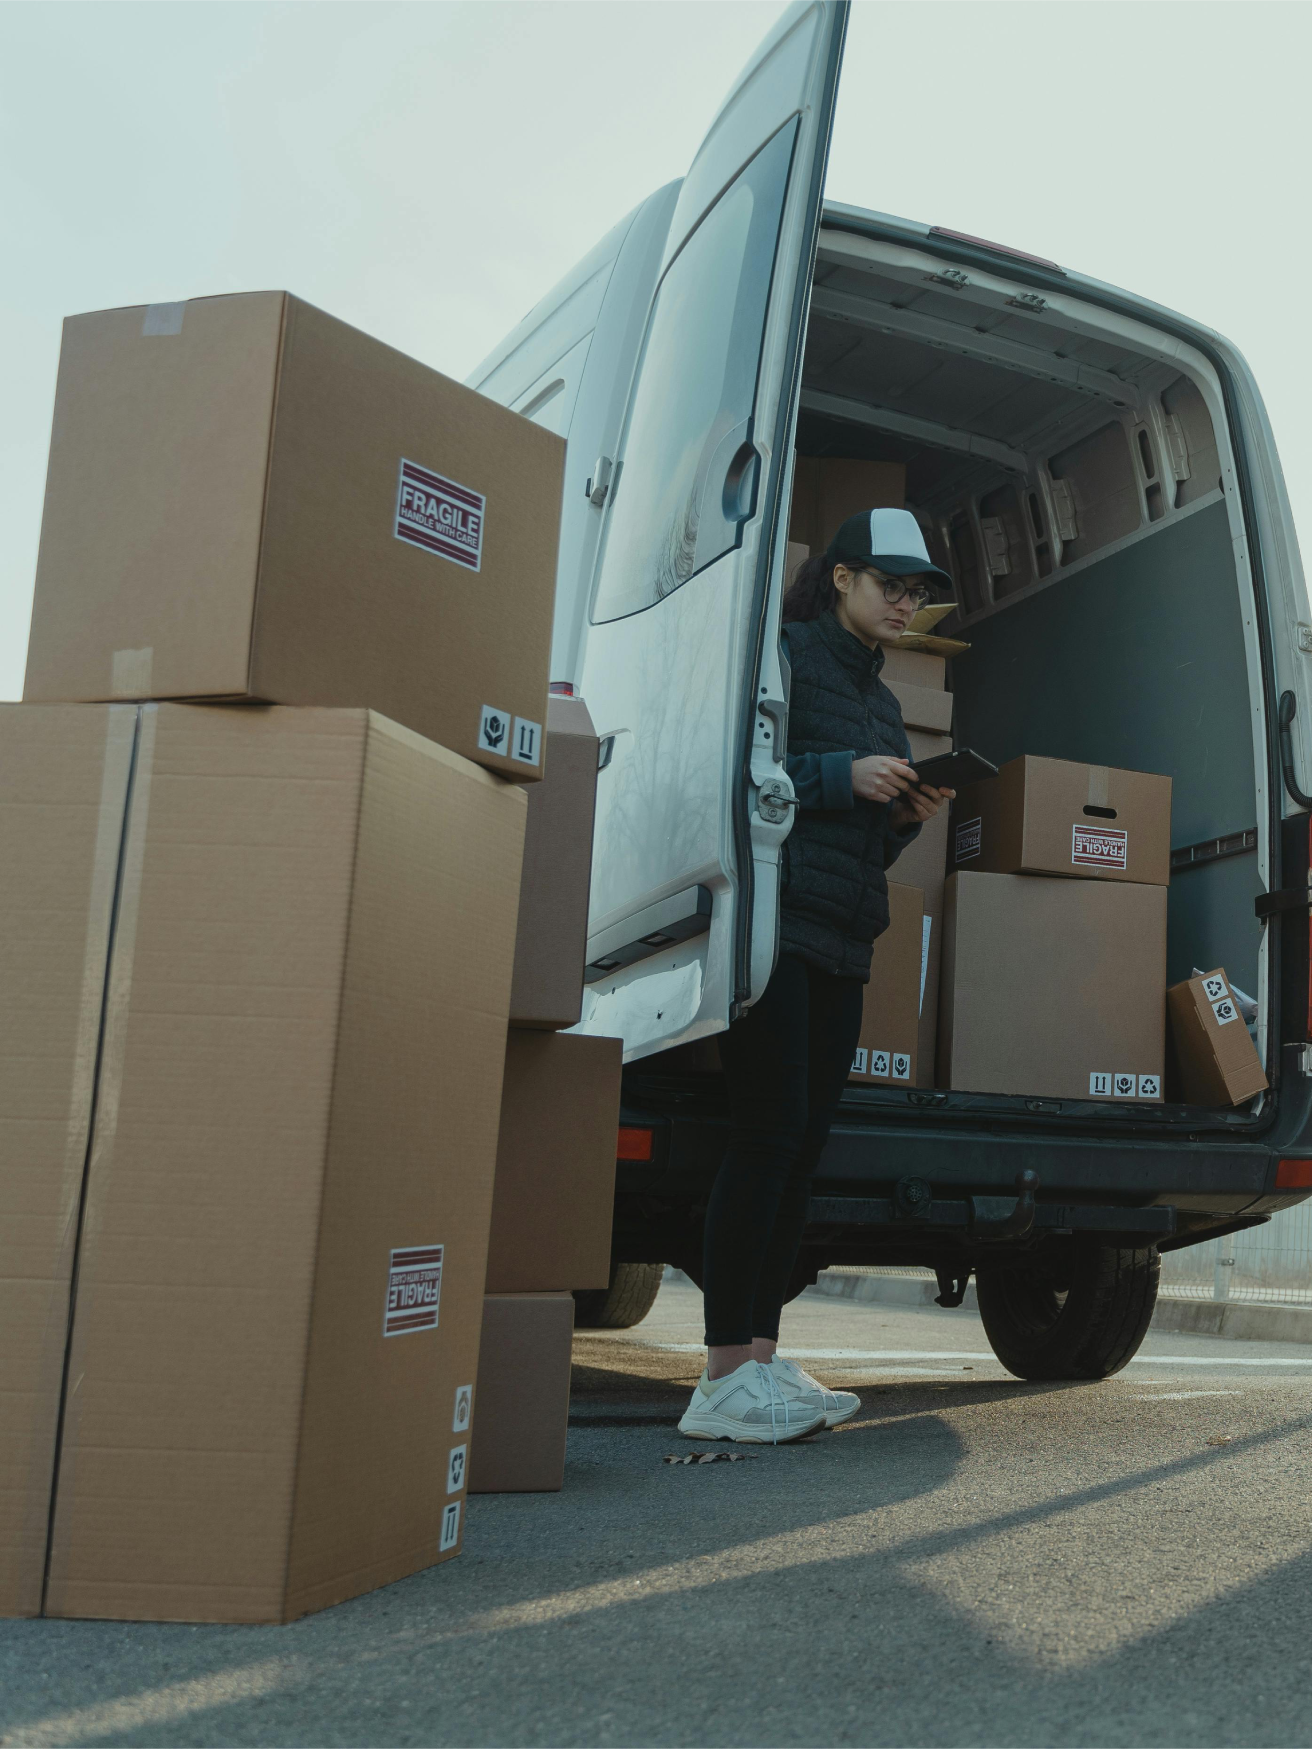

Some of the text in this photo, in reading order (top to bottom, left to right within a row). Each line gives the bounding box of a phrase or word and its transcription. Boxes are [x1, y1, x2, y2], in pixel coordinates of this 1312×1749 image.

[401, 485, 479, 538] FRAGILE
[401, 507, 478, 548] HANDLE WITH CARE
[1075, 841, 1125, 857] FRAGILE
[392, 1274, 407, 1285] CARE
[389, 1281, 439, 1308] FRAGILE
